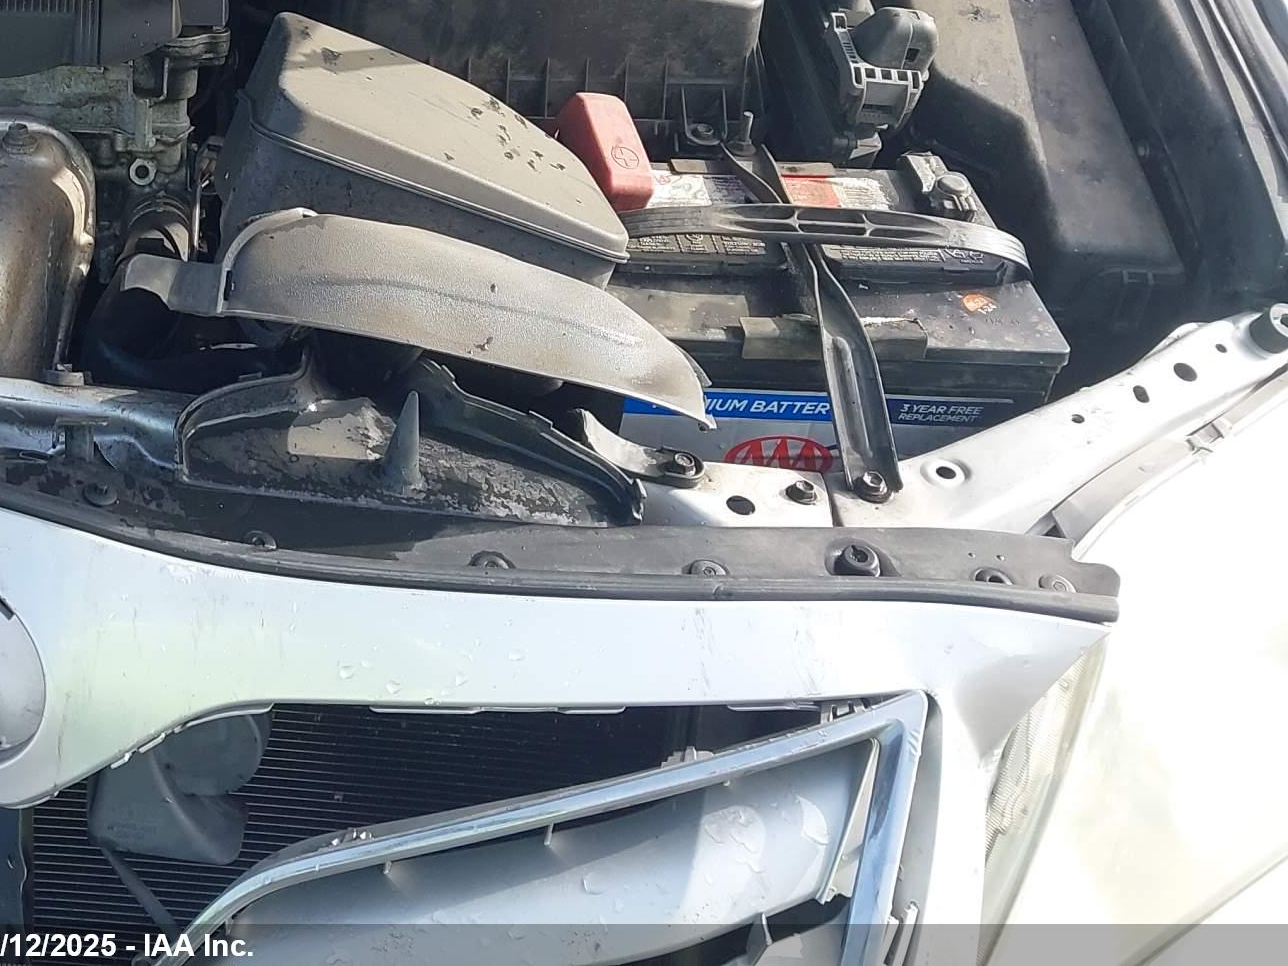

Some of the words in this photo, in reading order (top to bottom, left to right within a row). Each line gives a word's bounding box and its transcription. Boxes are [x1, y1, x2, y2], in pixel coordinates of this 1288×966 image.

[750, 400, 831, 415] BATTER
[900, 403, 911, 412] 3
[912, 404, 945, 414] YEAR
[947, 406, 984, 415] FREE
[898, 413, 979, 423] REPLACEMENT
